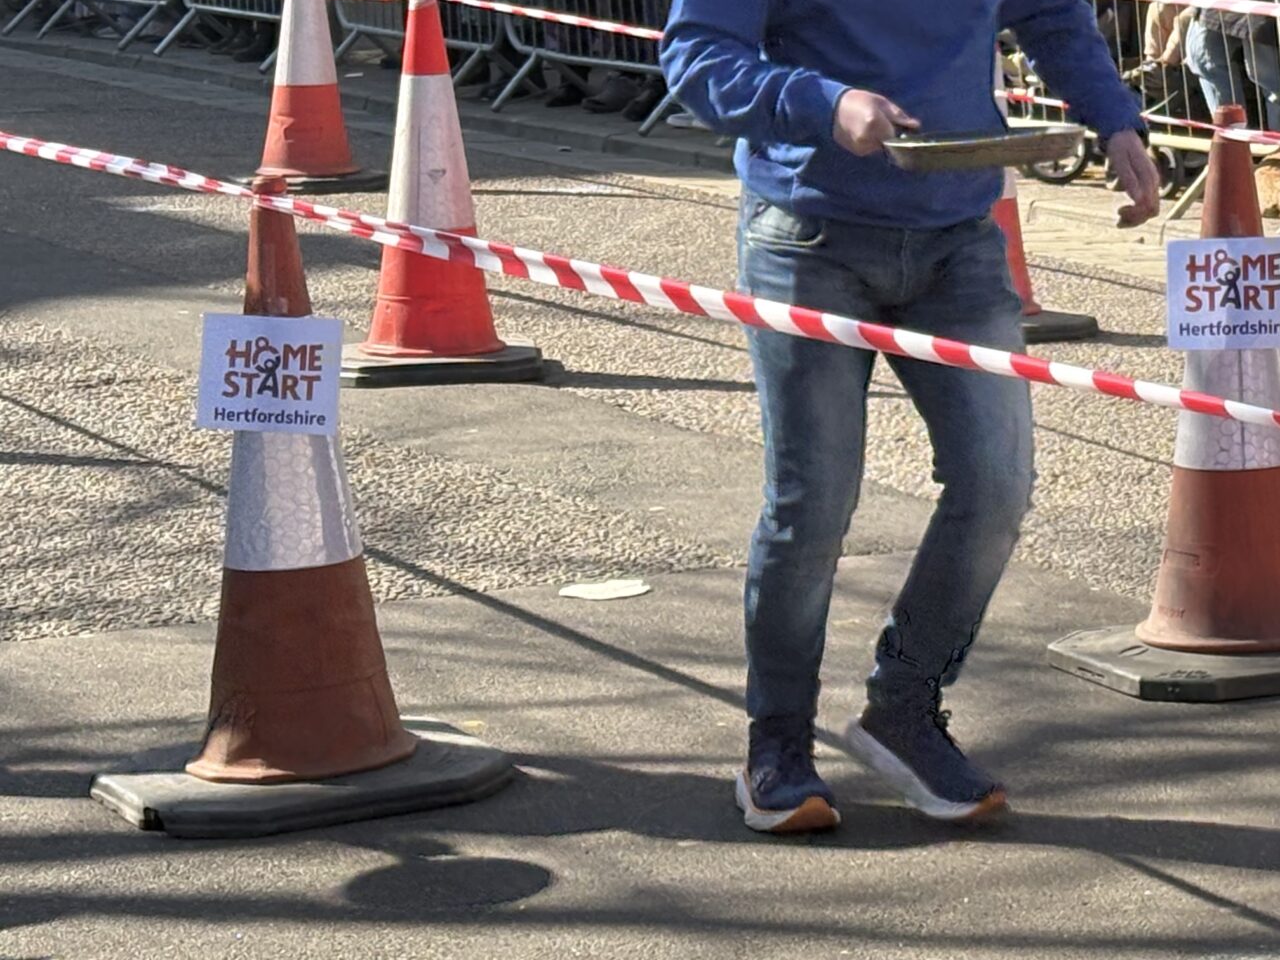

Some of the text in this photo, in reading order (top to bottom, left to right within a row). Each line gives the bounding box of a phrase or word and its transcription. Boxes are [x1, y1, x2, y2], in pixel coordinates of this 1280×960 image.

[225, 336, 324, 373] HOME
[221, 371, 322, 401] START
[214, 406, 326, 426] Hertfordshire
